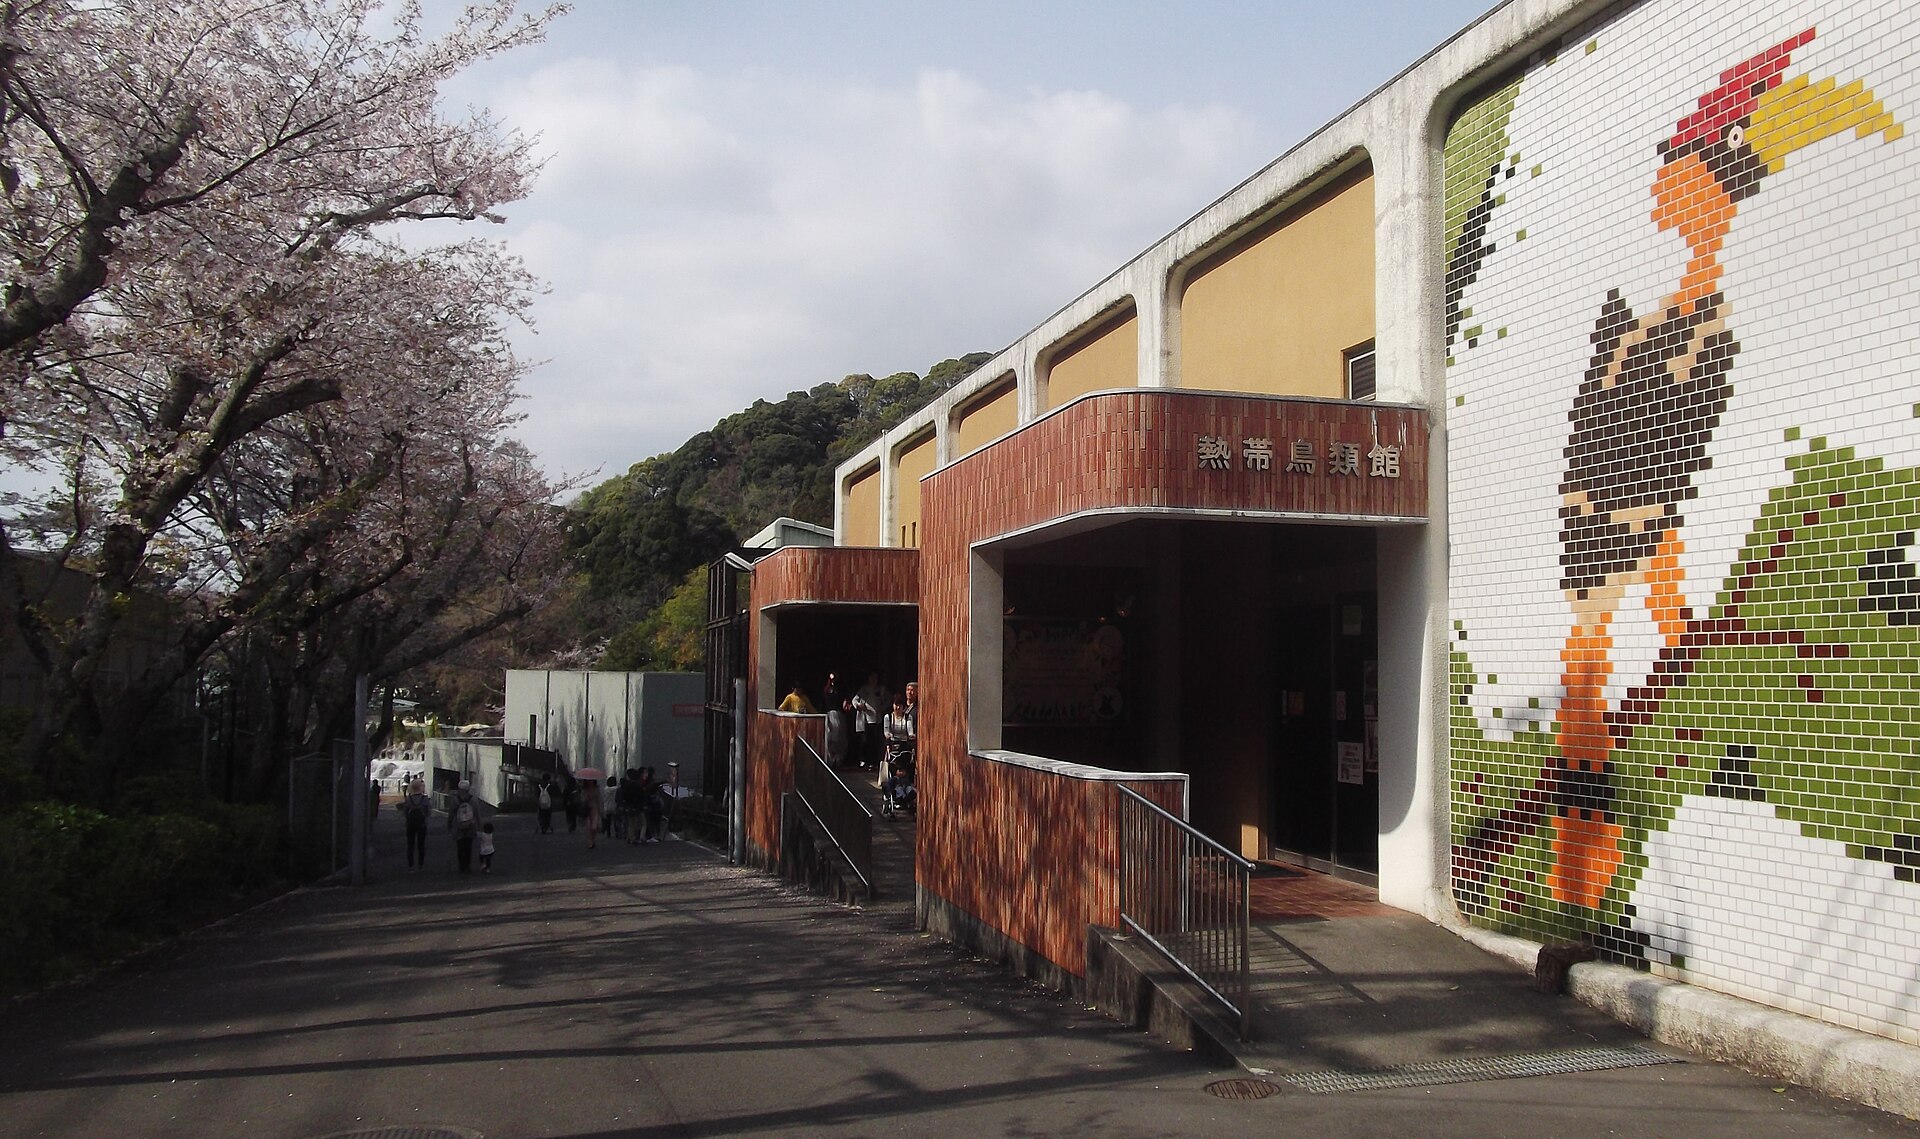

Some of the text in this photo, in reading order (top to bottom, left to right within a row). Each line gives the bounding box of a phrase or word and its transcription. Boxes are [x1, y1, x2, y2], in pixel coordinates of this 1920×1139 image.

[1197, 435, 1401, 478] 熱帯鳥類館
